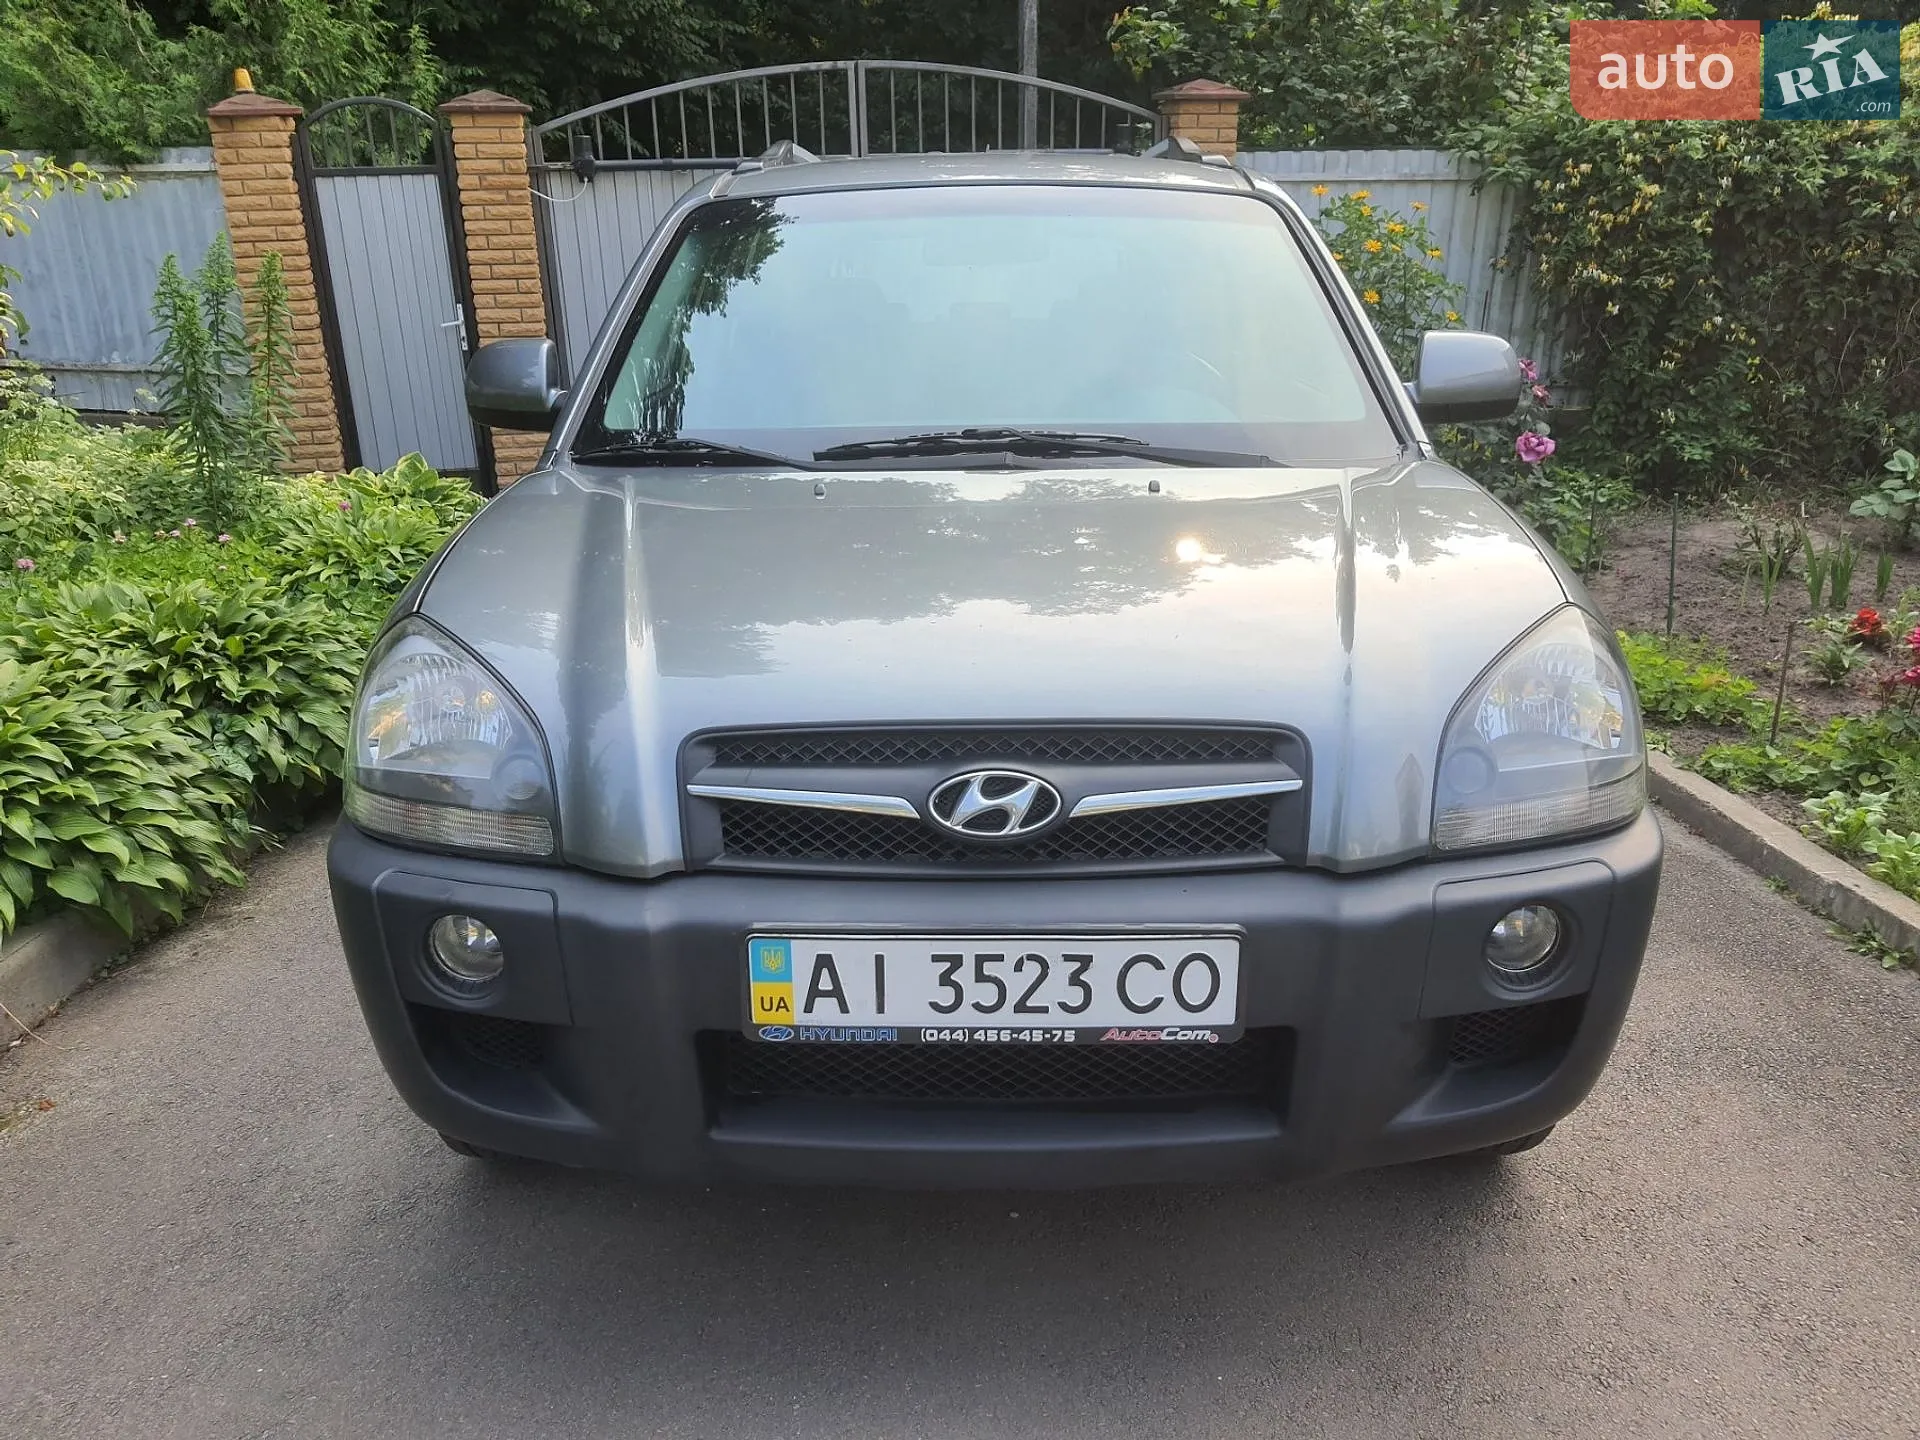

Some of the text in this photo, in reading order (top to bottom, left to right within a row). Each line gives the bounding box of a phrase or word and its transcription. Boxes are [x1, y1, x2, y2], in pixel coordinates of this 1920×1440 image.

[802, 953, 1221, 1014] AI 3523 CO
[761, 995, 791, 1014] UA
[800, 1027, 897, 1041] HYUNDAI
[920, 1028, 1076, 1043] (044) 456-45-75
